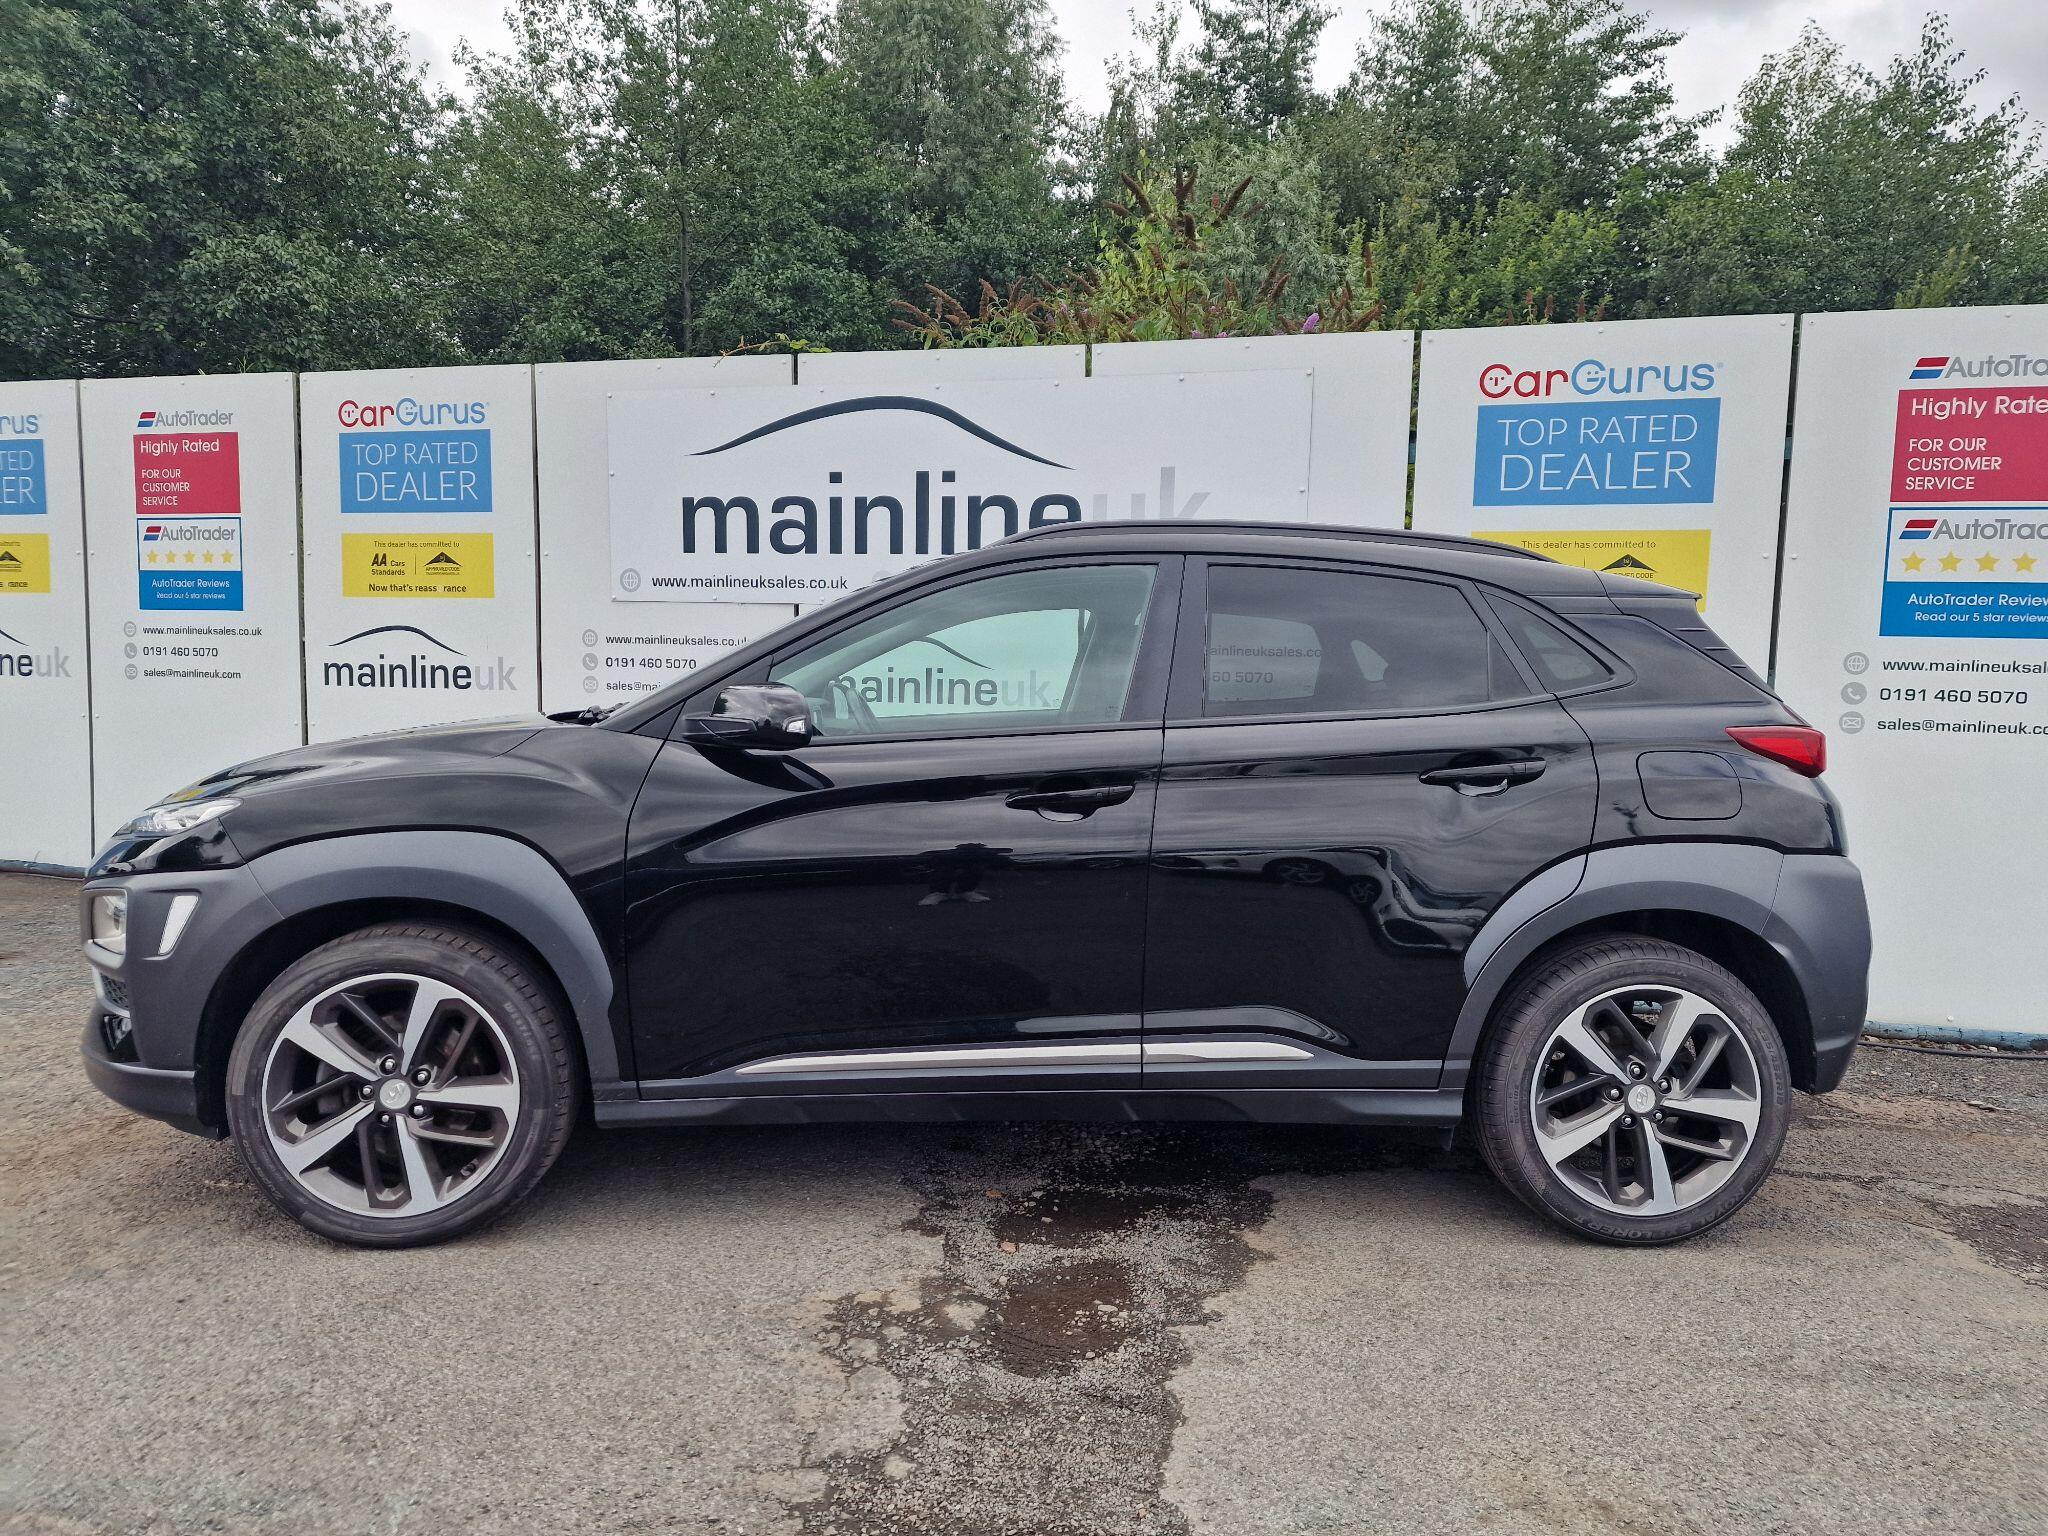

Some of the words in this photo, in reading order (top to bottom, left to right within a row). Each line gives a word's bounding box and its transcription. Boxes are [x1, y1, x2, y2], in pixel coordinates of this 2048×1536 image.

[1479, 358, 1716, 399] CarGurus
[338, 397, 486, 428] CarGurus
[1911, 396, 1988, 421] Highly
[156, 410, 234, 427] AutoTrader
[1497, 419, 1568, 446] TOP
[1579, 414, 1699, 445] RATED
[140, 440, 178, 455] Highly
[182, 438, 219, 453] Rated
[1908, 438, 1943, 452] FOR
[1948, 437, 1987, 451] OUR
[352, 443, 397, 466] TOP
[404, 441, 478, 465] RATED
[1907, 456, 2002, 471] CUSTOMER
[141, 469, 159, 479] FOR
[161, 468, 181, 478] OUR
[1500, 450, 1693, 492] DEALER
[142, 482, 190, 492] CUSTOMER
[356, 470, 479, 502] DEALER
[1905, 476, 1975, 490] SERVICE
[142, 495, 178, 506] SERVICE
[160, 525, 236, 541] AutoTrader
[1521, 541, 1541, 549] This
[1543, 541, 1573, 549] dealer
[1575, 541, 1590, 549] has
[1592, 541, 1644, 549] committed
[1645, 541, 1657, 549] to
[371, 553, 387, 567] AA
[371, 568, 406, 576] Standards
[151, 579, 195, 588] AutoTrader
[197, 579, 230, 588] Reviews
[369, 584, 388, 592] Now
[390, 584, 413, 592] that's
[415, 584, 467, 592] reassrance
[652, 575, 849, 590] www.mainlineuksales.co.uk
[1907, 593, 1994, 606] AutoTrader
[1914, 611, 1946, 622] Read
[1950, 613, 1970, 622] our
[1972, 612, 1981, 622] 5
[1983, 613, 2004, 622] star
[143, 625, 262, 636] www.mainlineuksales.co.uk
[143, 646, 167, 656] 0191
[170, 647, 190, 656] 460
[192, 647, 219, 657] 5070
[606, 656, 635, 668] 0191
[639, 657, 663, 669] 460
[665, 658, 697, 670] 5070
[143, 668, 241, 679] sales@mainlineuk.com
[324, 654, 516, 690] mainlineuk
[1235, 672, 1274, 684] 5070
[1879, 687, 1927, 702] 0191
[1933, 689, 1972, 703] 460
[1977, 690, 2028, 704] 5070
